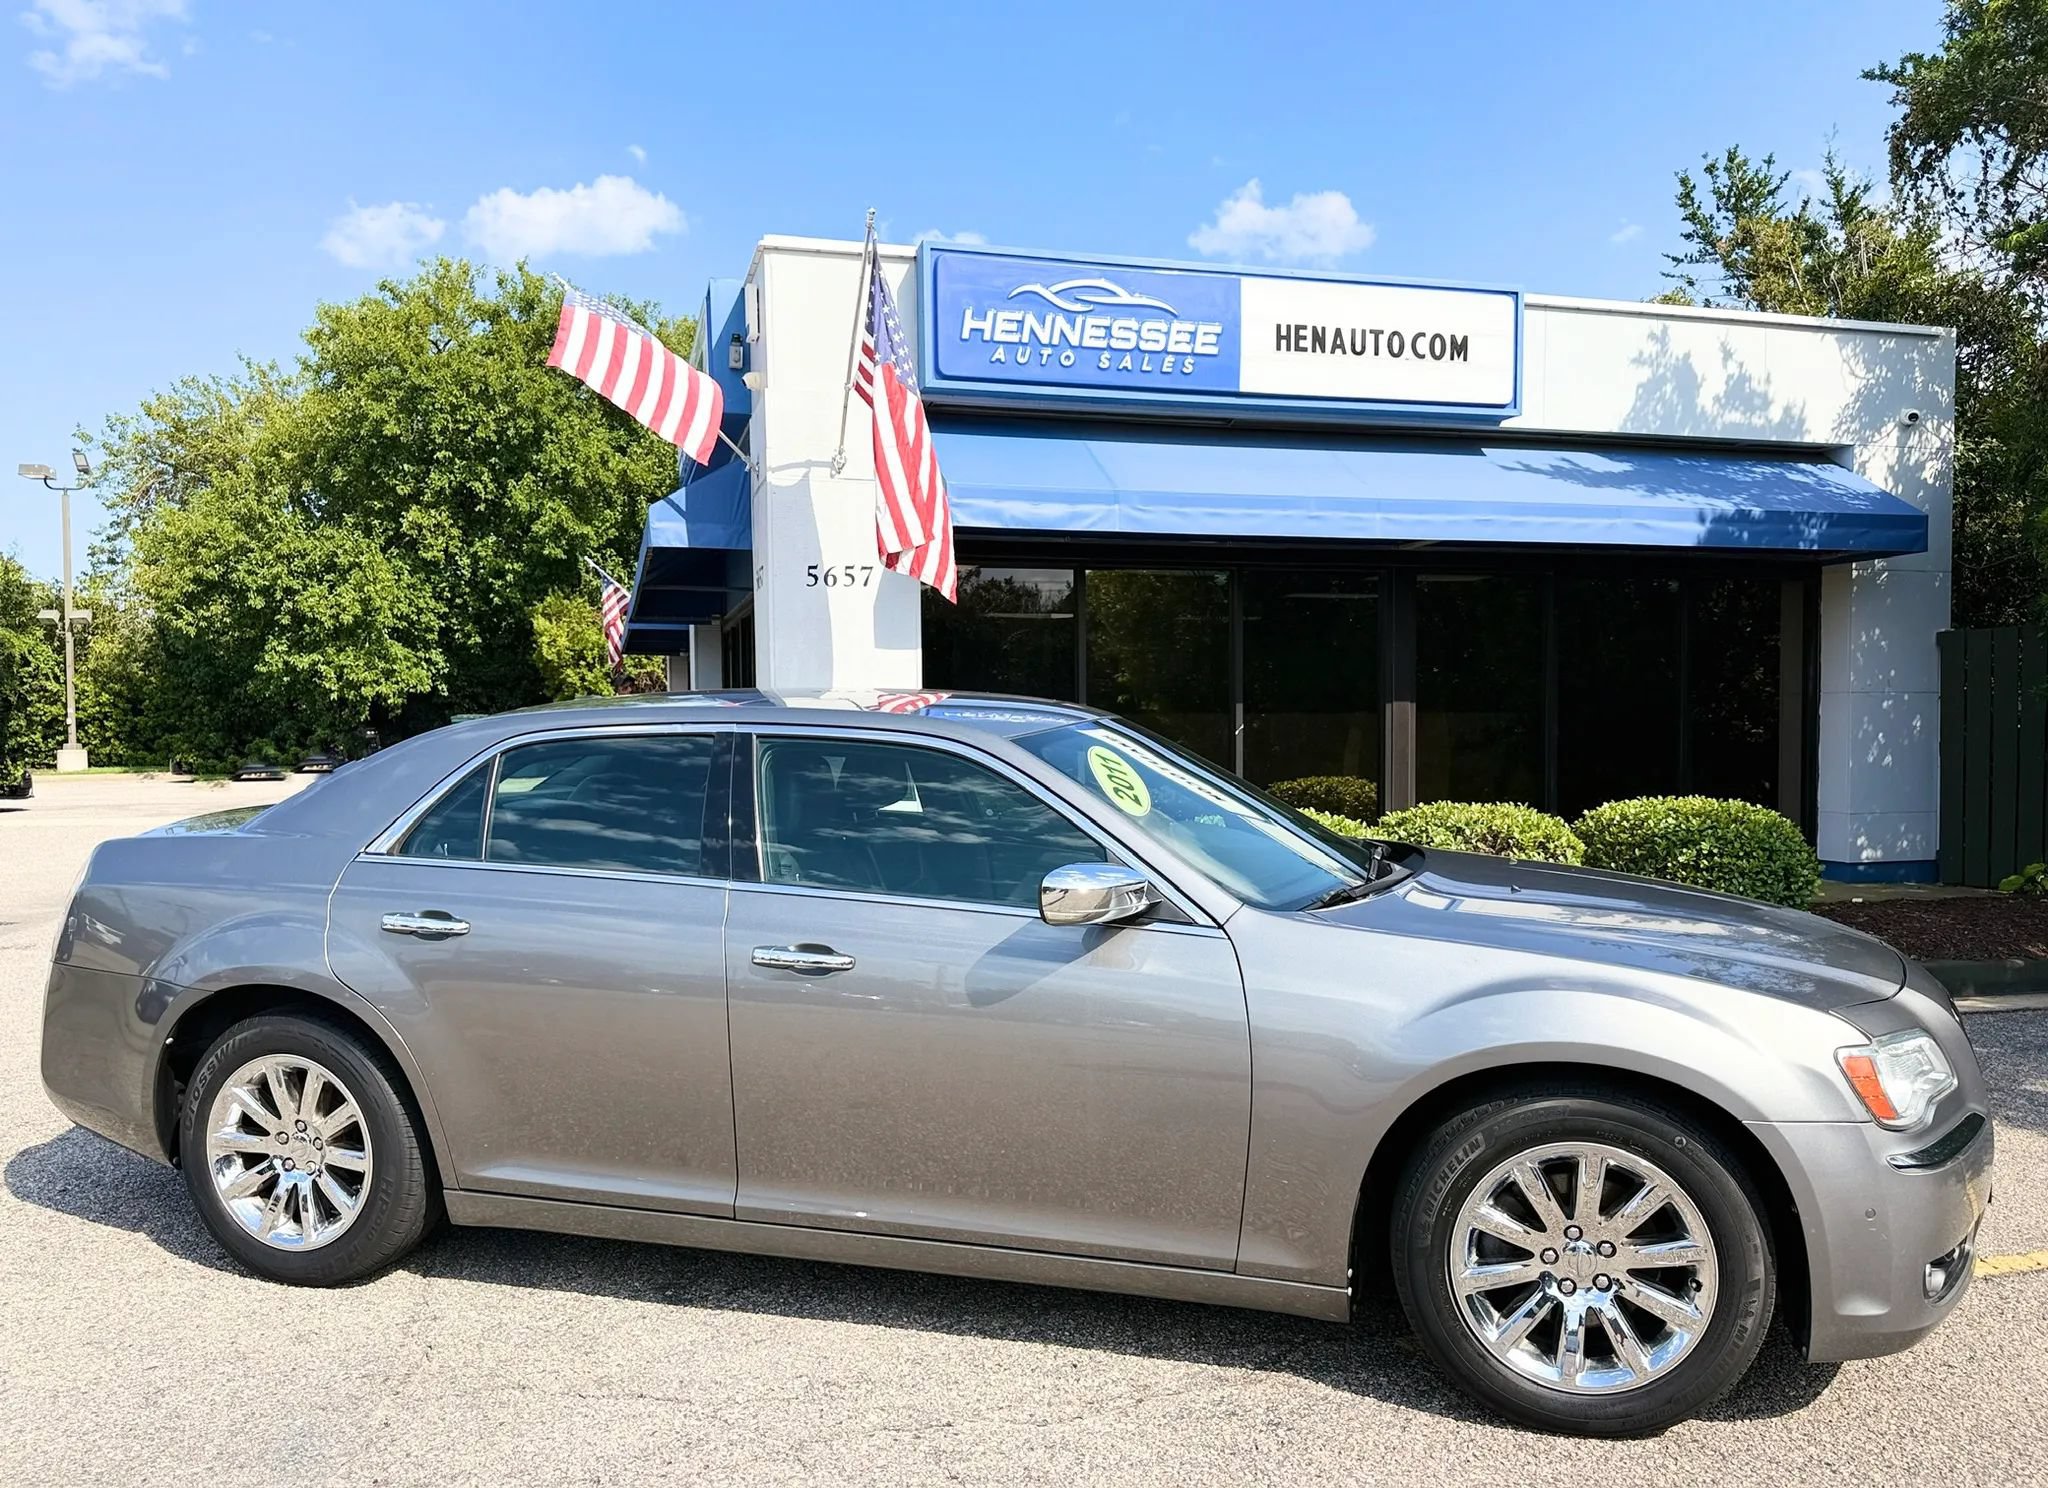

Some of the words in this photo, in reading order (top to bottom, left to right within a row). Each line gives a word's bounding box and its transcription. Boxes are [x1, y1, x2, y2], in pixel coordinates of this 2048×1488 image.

[961, 307, 1222, 355] HENNESSEE
[990, 344, 1076, 367] AUTO
[1098, 351, 1196, 375] SALES
[806, 564, 873, 587] 5657
[1095, 752, 1144, 808] 2011
[1423, 1137, 1482, 1218] MICHELIN
